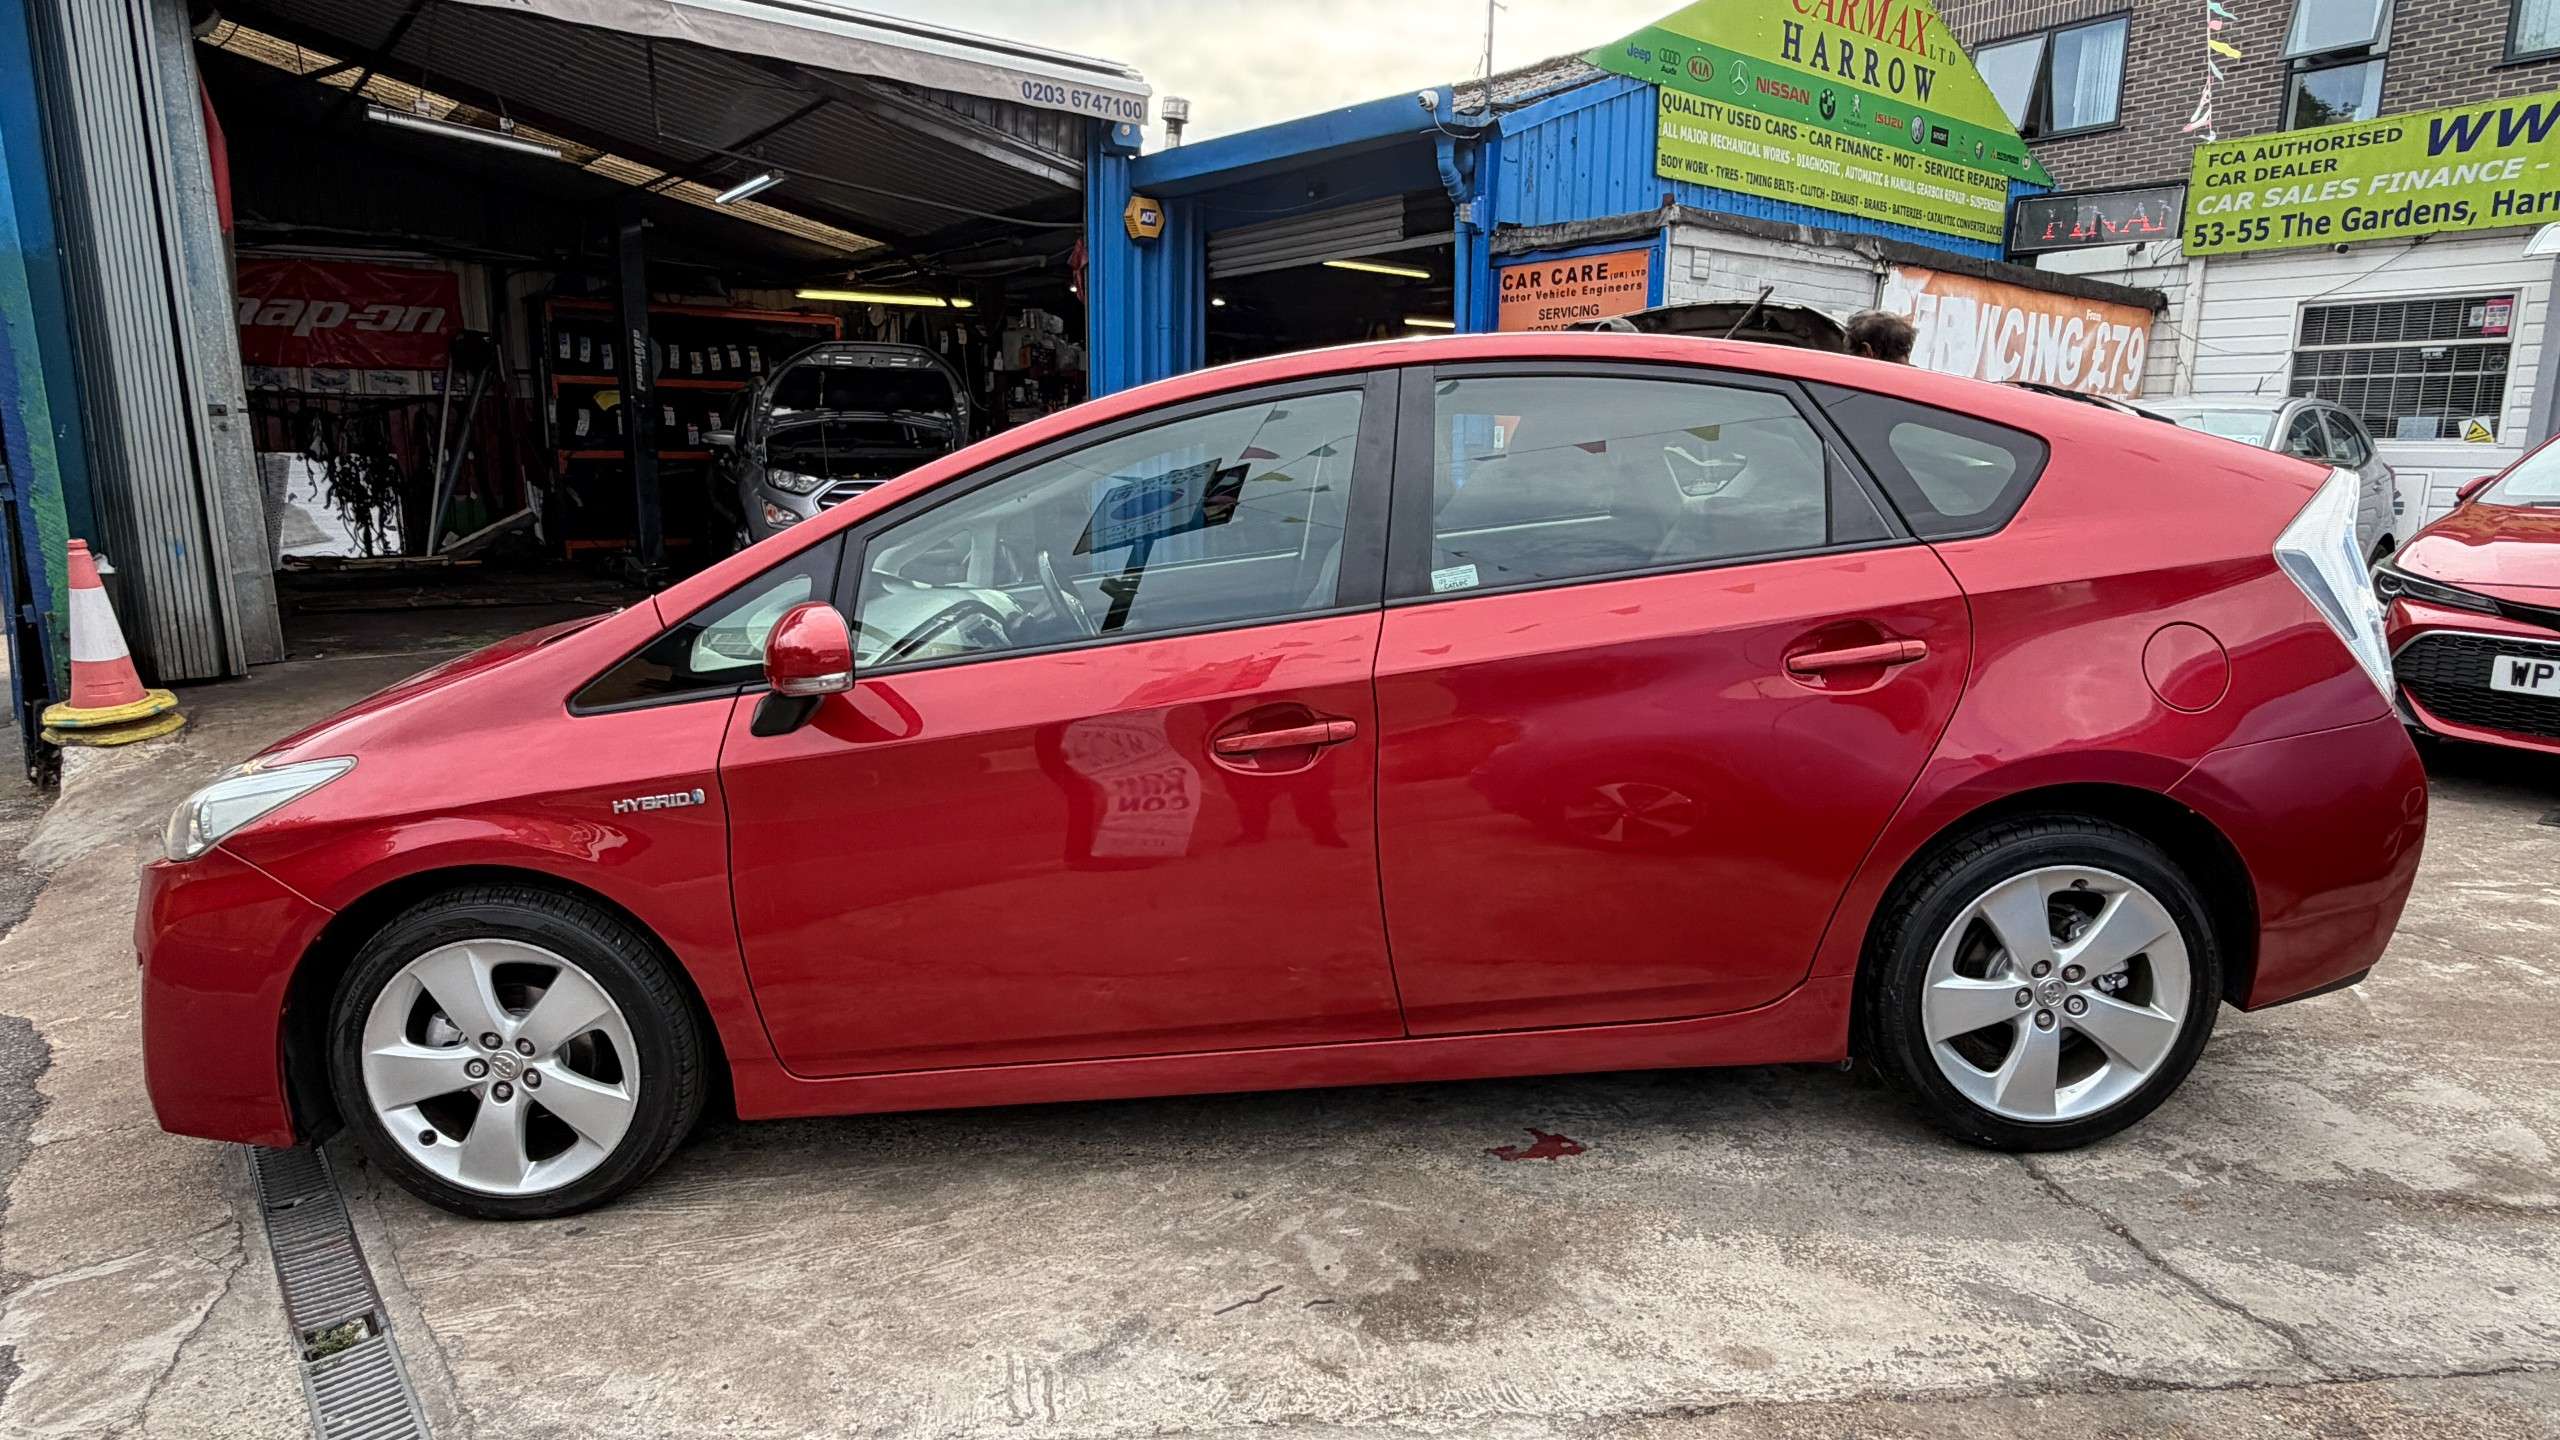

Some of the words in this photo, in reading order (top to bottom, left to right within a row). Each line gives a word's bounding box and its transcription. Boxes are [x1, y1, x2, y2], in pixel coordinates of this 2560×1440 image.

[1792, 0, 1936, 57] ARMAX
[1929, 44, 1956, 66] LTD
[1627, 42, 1651, 63] Jeep
[1781, 19, 1936, 103] HARROW
[1660, 65, 1677, 76] Audi
[1691, 60, 1709, 77] KIA
[1022, 80, 1066, 104] 0203
[1071, 90, 1142, 120] 6747100
[1756, 76, 1810, 105] NISSAN
[1875, 112, 1904, 129] ISUZU
[1662, 92, 1723, 121] QUALITY
[1728, 109, 1761, 131] USED
[1766, 119, 1797, 140] CARS
[1809, 130, 1832, 150] CAR
[1835, 137, 1883, 162] FINANCE
[1894, 152, 1916, 170] MOT
[1925, 160, 1964, 183] SERVICE
[1967, 171, 2007, 192] REPAIRS
[2208, 150, 2246, 168] FCA
[2253, 127, 2403, 162] AUTHORISED
[1662, 121, 1679, 138] ALL
[1680, 125, 1709, 146] MAJOR
[1710, 132, 1761, 158] MECHANICAL
[1762, 145, 1790, 164] WORKS
[1797, 153, 1840, 176] DIAGNOSTIC
[1845, 166, 1883, 186] AUTOMATIC
[1890, 176, 1916, 193] MANUAL
[1916, 182, 1943, 199] GEARBOX
[1945, 189, 1966, 205] REPAIR
[2205, 170, 2246, 188] CAR
[2254, 158, 2338, 182] DEALER
[1661, 153, 1683, 169] BODY
[1685, 160, 1709, 176] WORK
[1716, 165, 1739, 181] TYRES
[1745, 172, 1773, 188] TIMING
[1774, 178, 1794, 194] BELTS
[1800, 184, 1825, 199] CLUTCH
[1831, 190, 1859, 207] EXHAUST
[1863, 197, 1888, 213] BRAKES
[1892, 203, 1923, 220] BATTERIES
[1927, 211, 1956, 228] CATALYTIC
[1956, 218, 1986, 233] CONVERTER
[2196, 191, 2255, 216] CAR
[2262, 177, 2361, 209] SALES
[2367, 156, 2527, 196] FINANCE
[1141, 210, 1156, 225] ADT
[2192, 216, 2271, 248] 53-55
[2280, 211, 2331, 239] The
[2341, 199, 2477, 233] Gardens,
[1502, 271, 1541, 291] CAR
[1551, 263, 1608, 285] CARE
[1631, 269, 1646, 277] LTD
[1501, 292, 1531, 304] Motor
[1536, 287, 1577, 300] Vehicle
[1582, 282, 1642, 297] Engineers
[238, 297, 446, 337] nap-on
[1538, 304, 1600, 321] SERVICING
[2089, 321, 2145, 392] £79
[2510, 660, 2560, 689] WP
[612, 792, 690, 814] HYBRID
